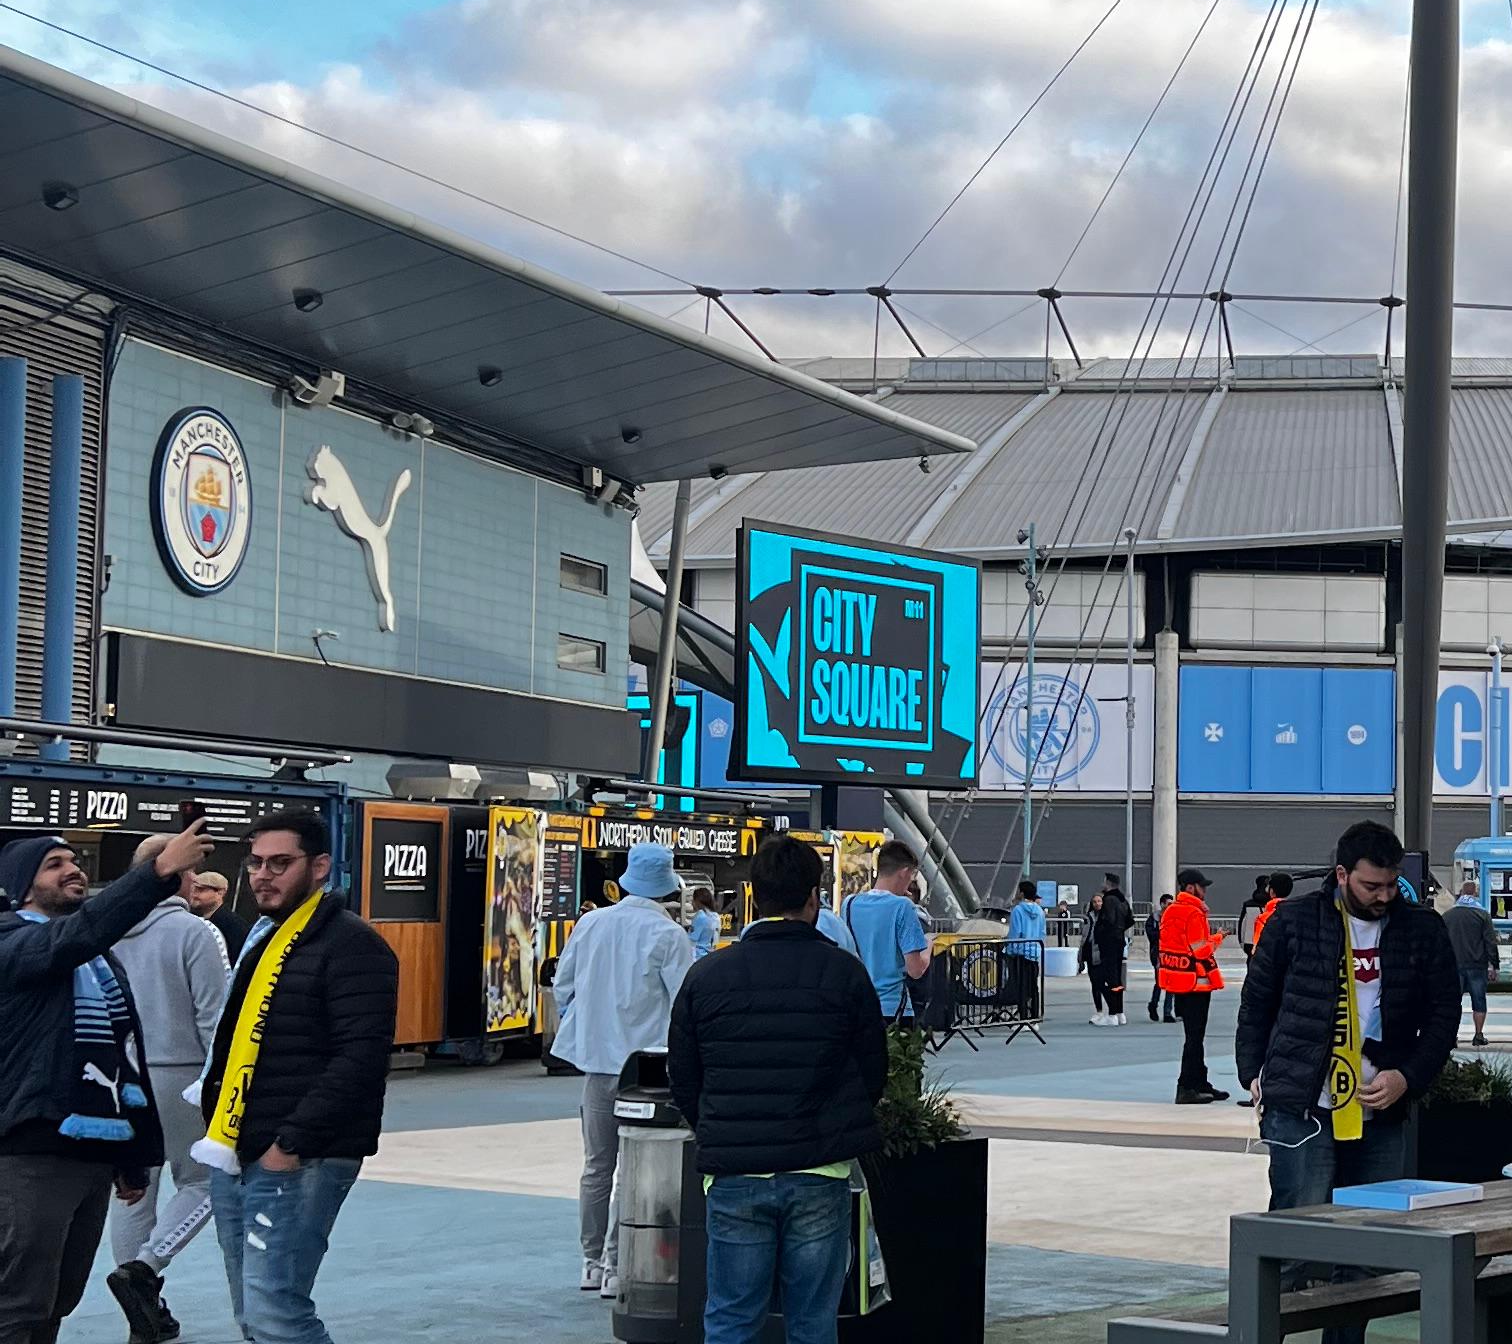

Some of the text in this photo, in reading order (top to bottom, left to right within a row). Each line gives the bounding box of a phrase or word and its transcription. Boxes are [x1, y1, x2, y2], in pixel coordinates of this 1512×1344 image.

[173, 422, 244, 487] MANCHESTER
[193, 560, 220, 580] CITY
[813, 586, 877, 656] CITY
[811, 658, 923, 731] SQUARE
[86, 790, 128, 820] PIZZA
[465, 828, 488, 859] PIZ
[598, 821, 651, 848] NORTHERN
[708, 829, 737, 854] CHEESE
[384, 844, 427, 877] PIZZA
